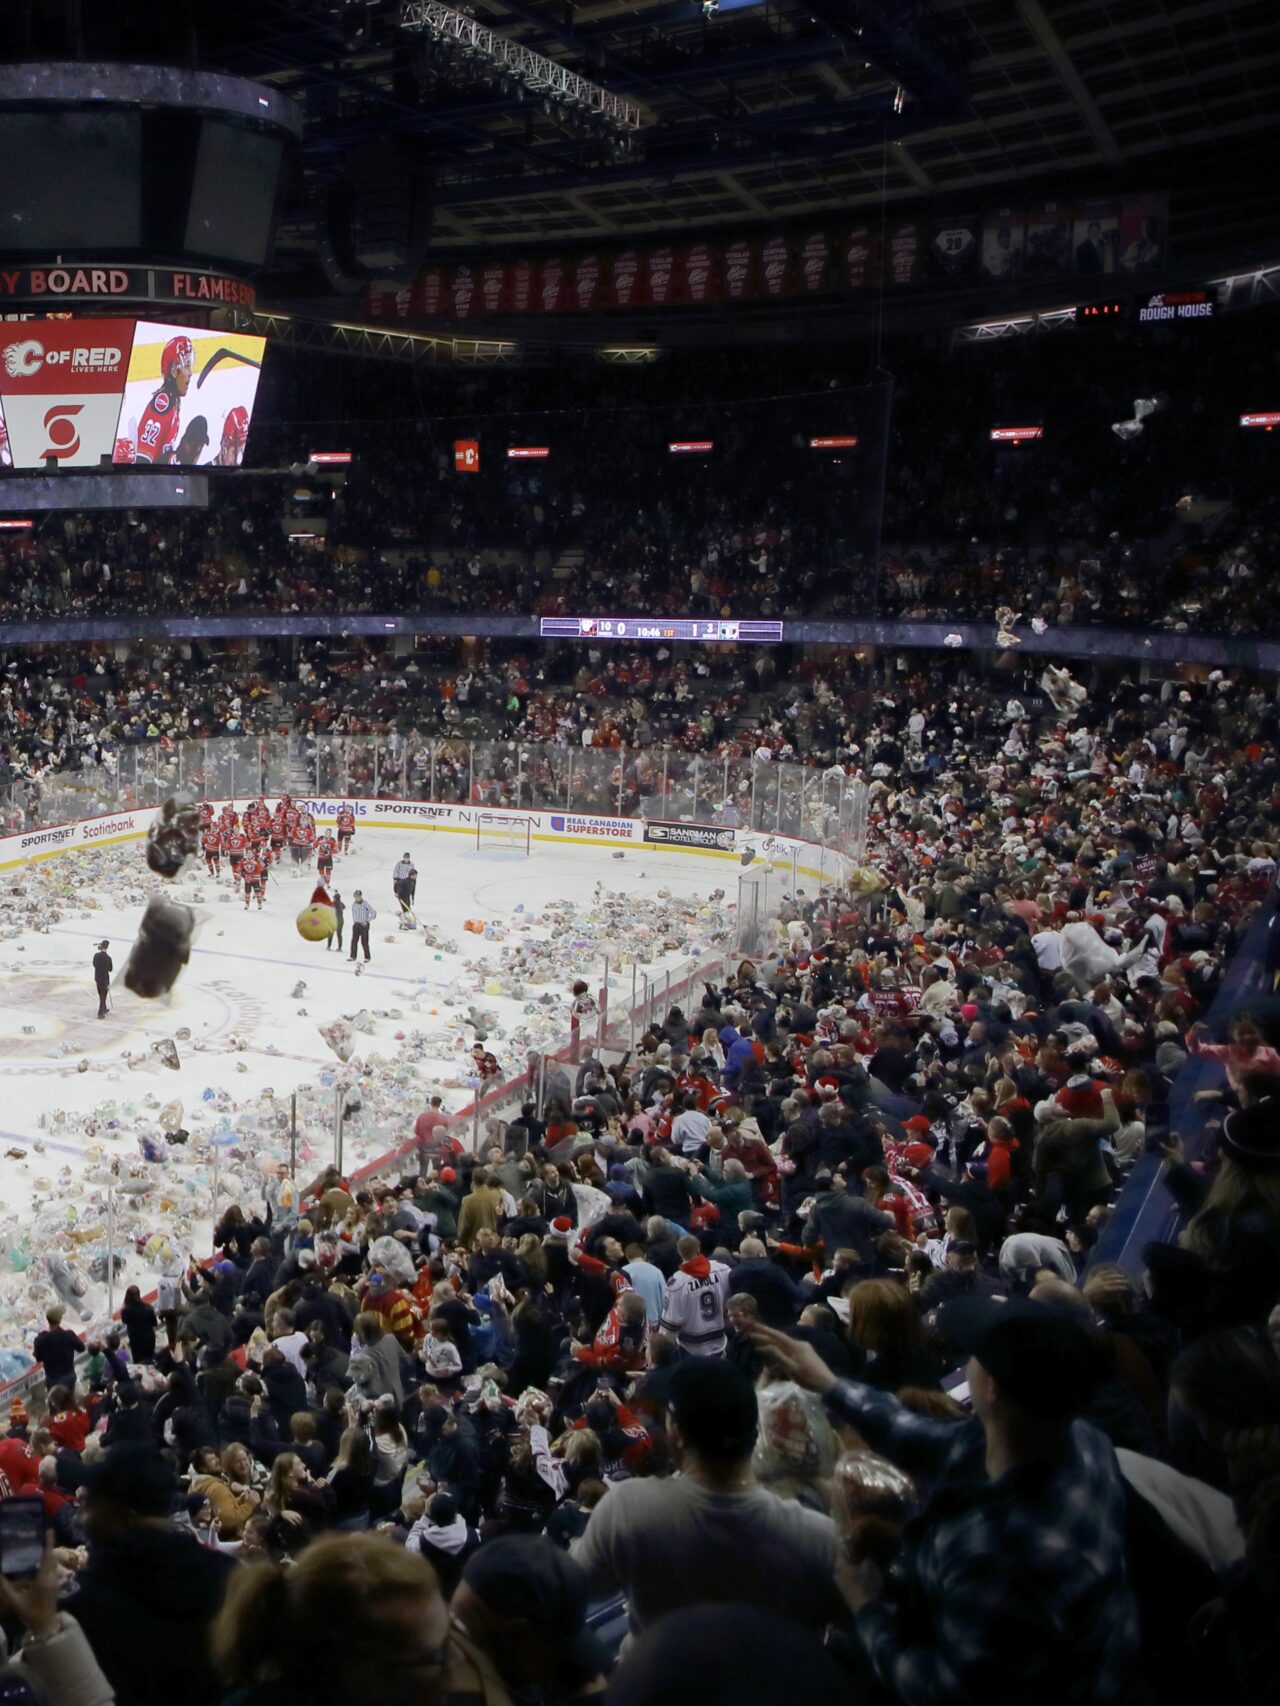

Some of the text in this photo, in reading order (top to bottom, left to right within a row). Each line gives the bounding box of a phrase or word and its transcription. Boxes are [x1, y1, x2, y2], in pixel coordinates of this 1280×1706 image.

[30, 268, 129, 295] BOARD
[173, 271, 239, 303] FLAMES
[1139, 302, 1213, 321] ROUGH HOUSE
[45, 351, 71, 365] OF
[71, 346, 122, 367] RED
[70, 365, 119, 374] LIVES HERE
[140, 421, 161, 446] 32
[600, 621, 612, 632] 10
[616, 622, 627, 635] 0
[637, 626, 661, 637] 10:46
[691, 623, 698, 637] 1
[705, 622, 714, 633] 3
[311, 800, 367, 815] Medals
[374, 803, 454, 817] SPORTSNET
[458, 810, 541, 828] NISSAN
[566, 817, 634, 829] REAL CANADIAN
[82, 816, 135, 841] Scotiabank
[566, 824, 633, 838] SUPERSTORE
[669, 827, 717, 841] SANDMAN
[21, 827, 76, 848] SPORTSNET
[669, 835, 692, 843] HOTEL
[699, 1290, 719, 1322] 9
